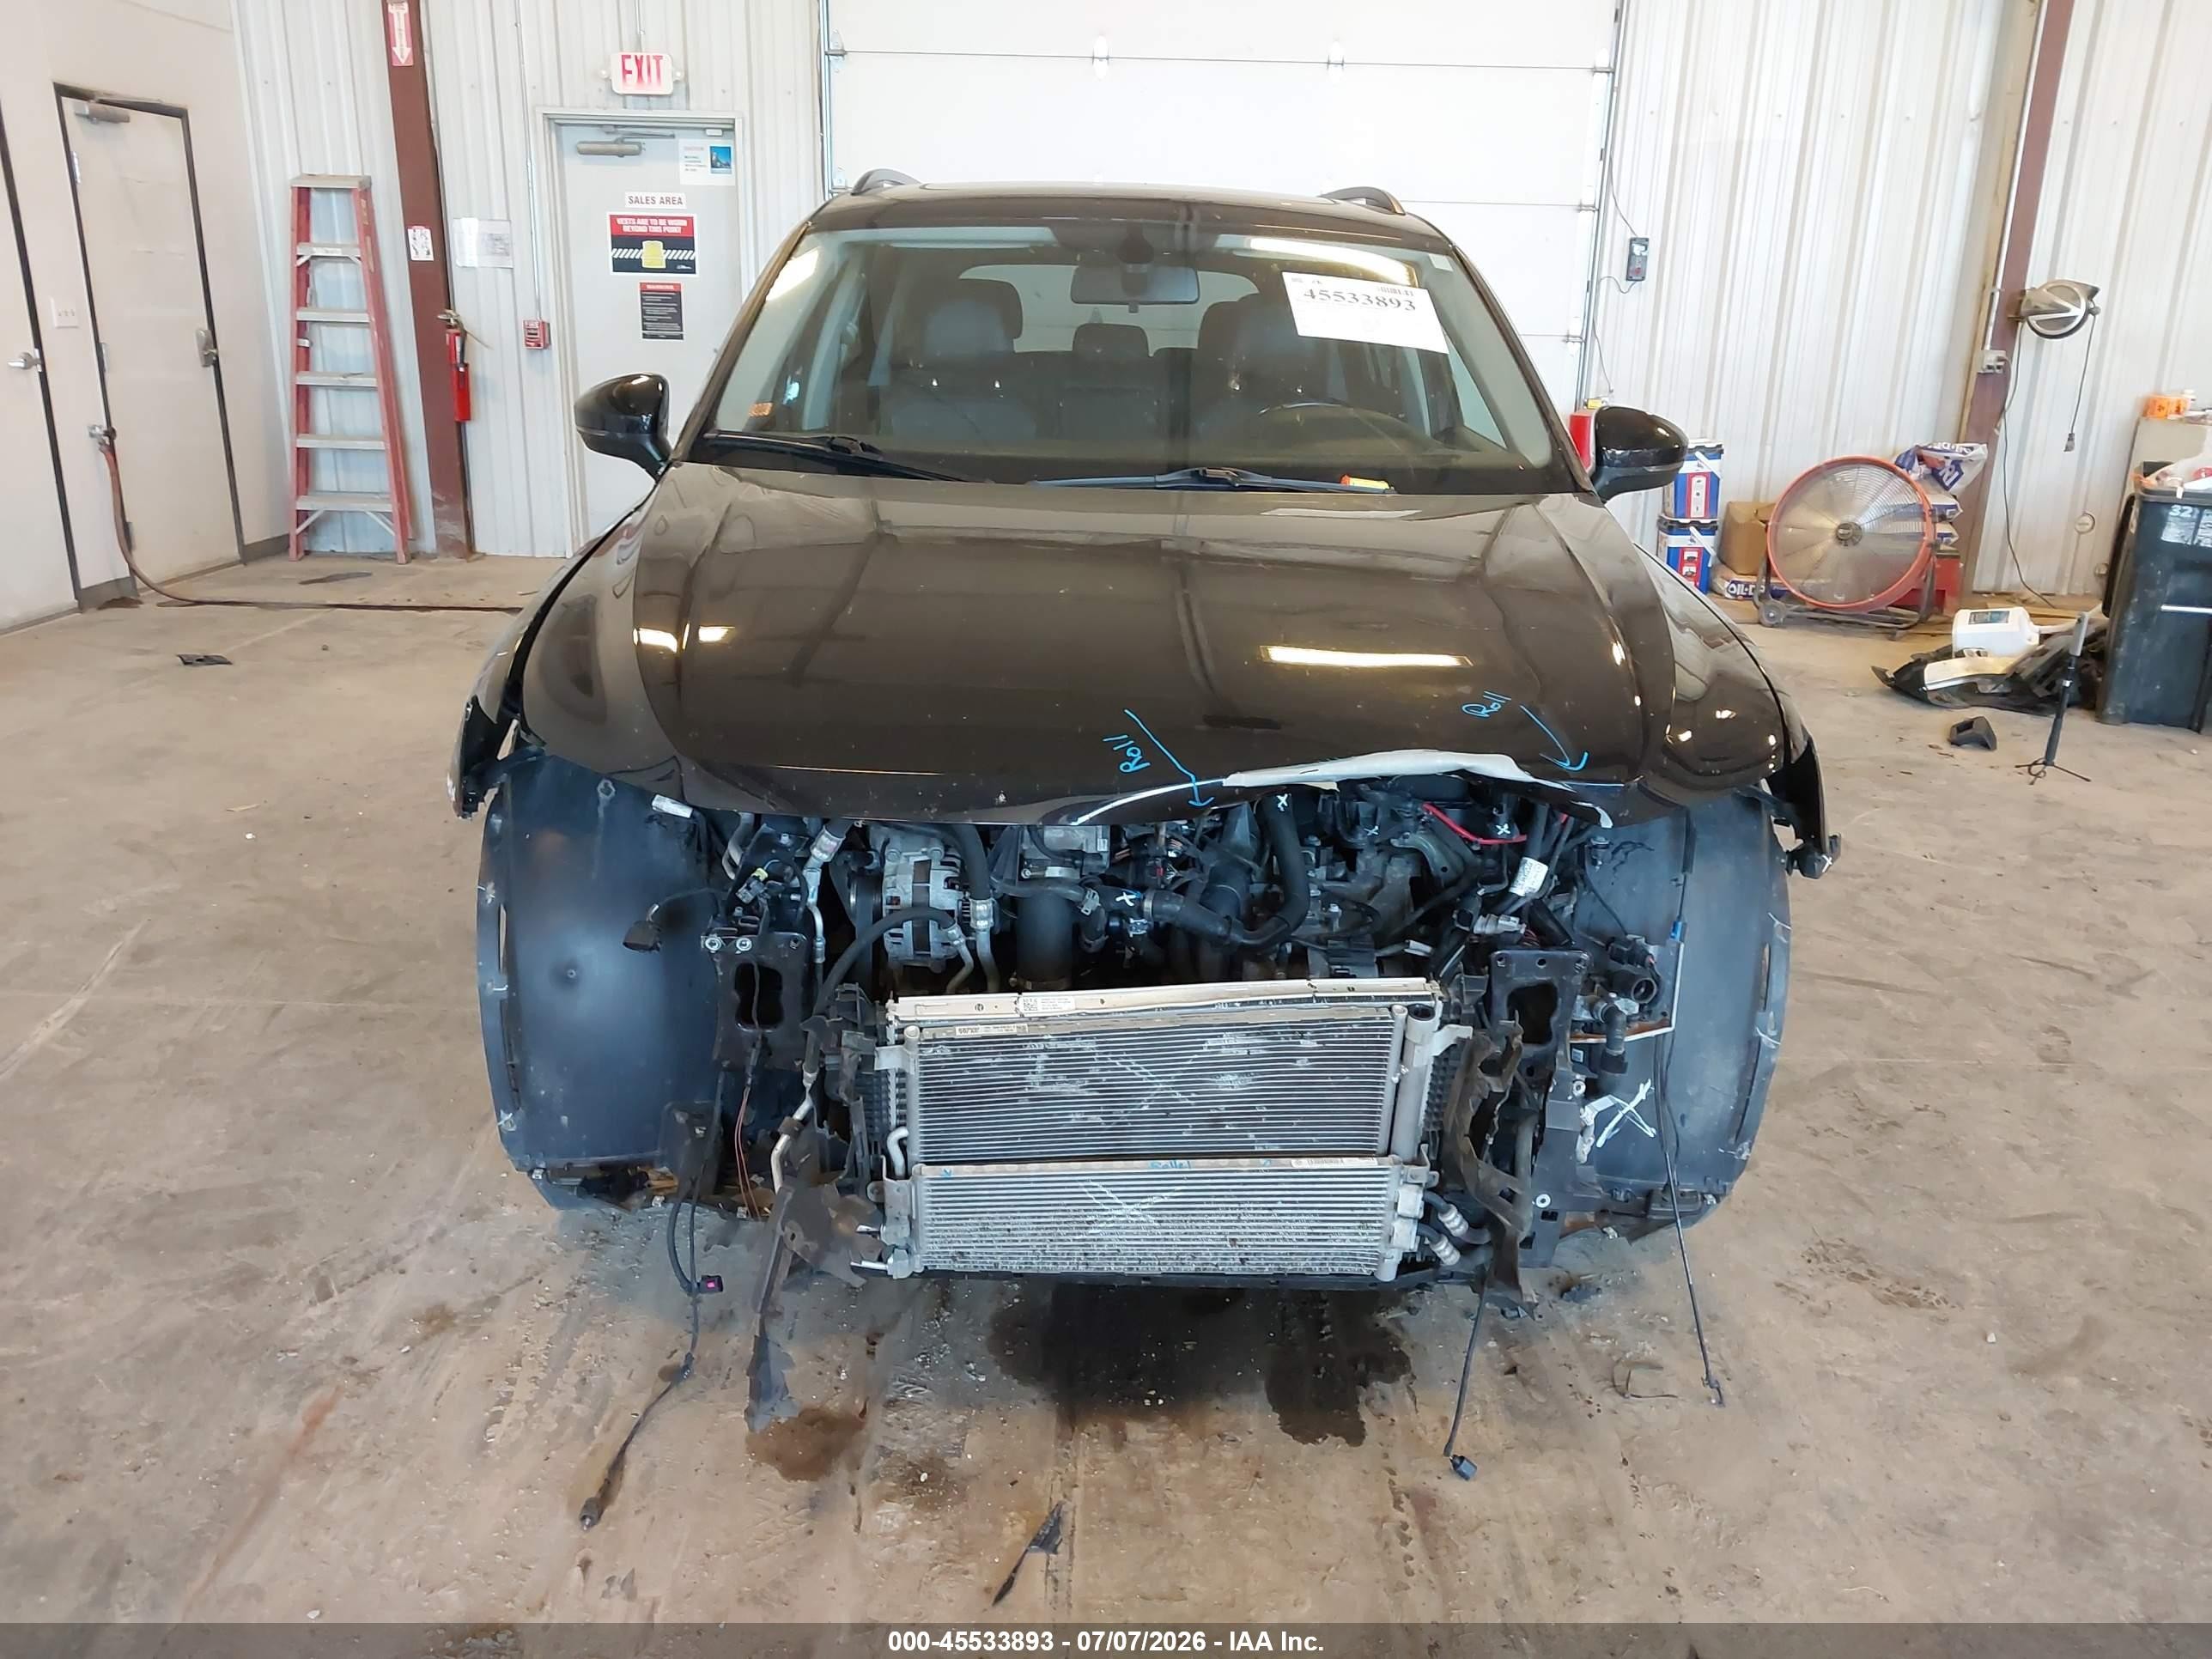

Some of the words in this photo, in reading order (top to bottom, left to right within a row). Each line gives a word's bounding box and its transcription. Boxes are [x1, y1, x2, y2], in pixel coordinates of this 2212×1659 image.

[621, 54, 665, 85] EXIT
[628, 196, 656, 204] SALES
[659, 196, 684, 205] AREA
[1304, 289, 1416, 311] 45533893
[1462, 690, 1511, 717] Roll
[1103, 734, 1151, 772] Roll
